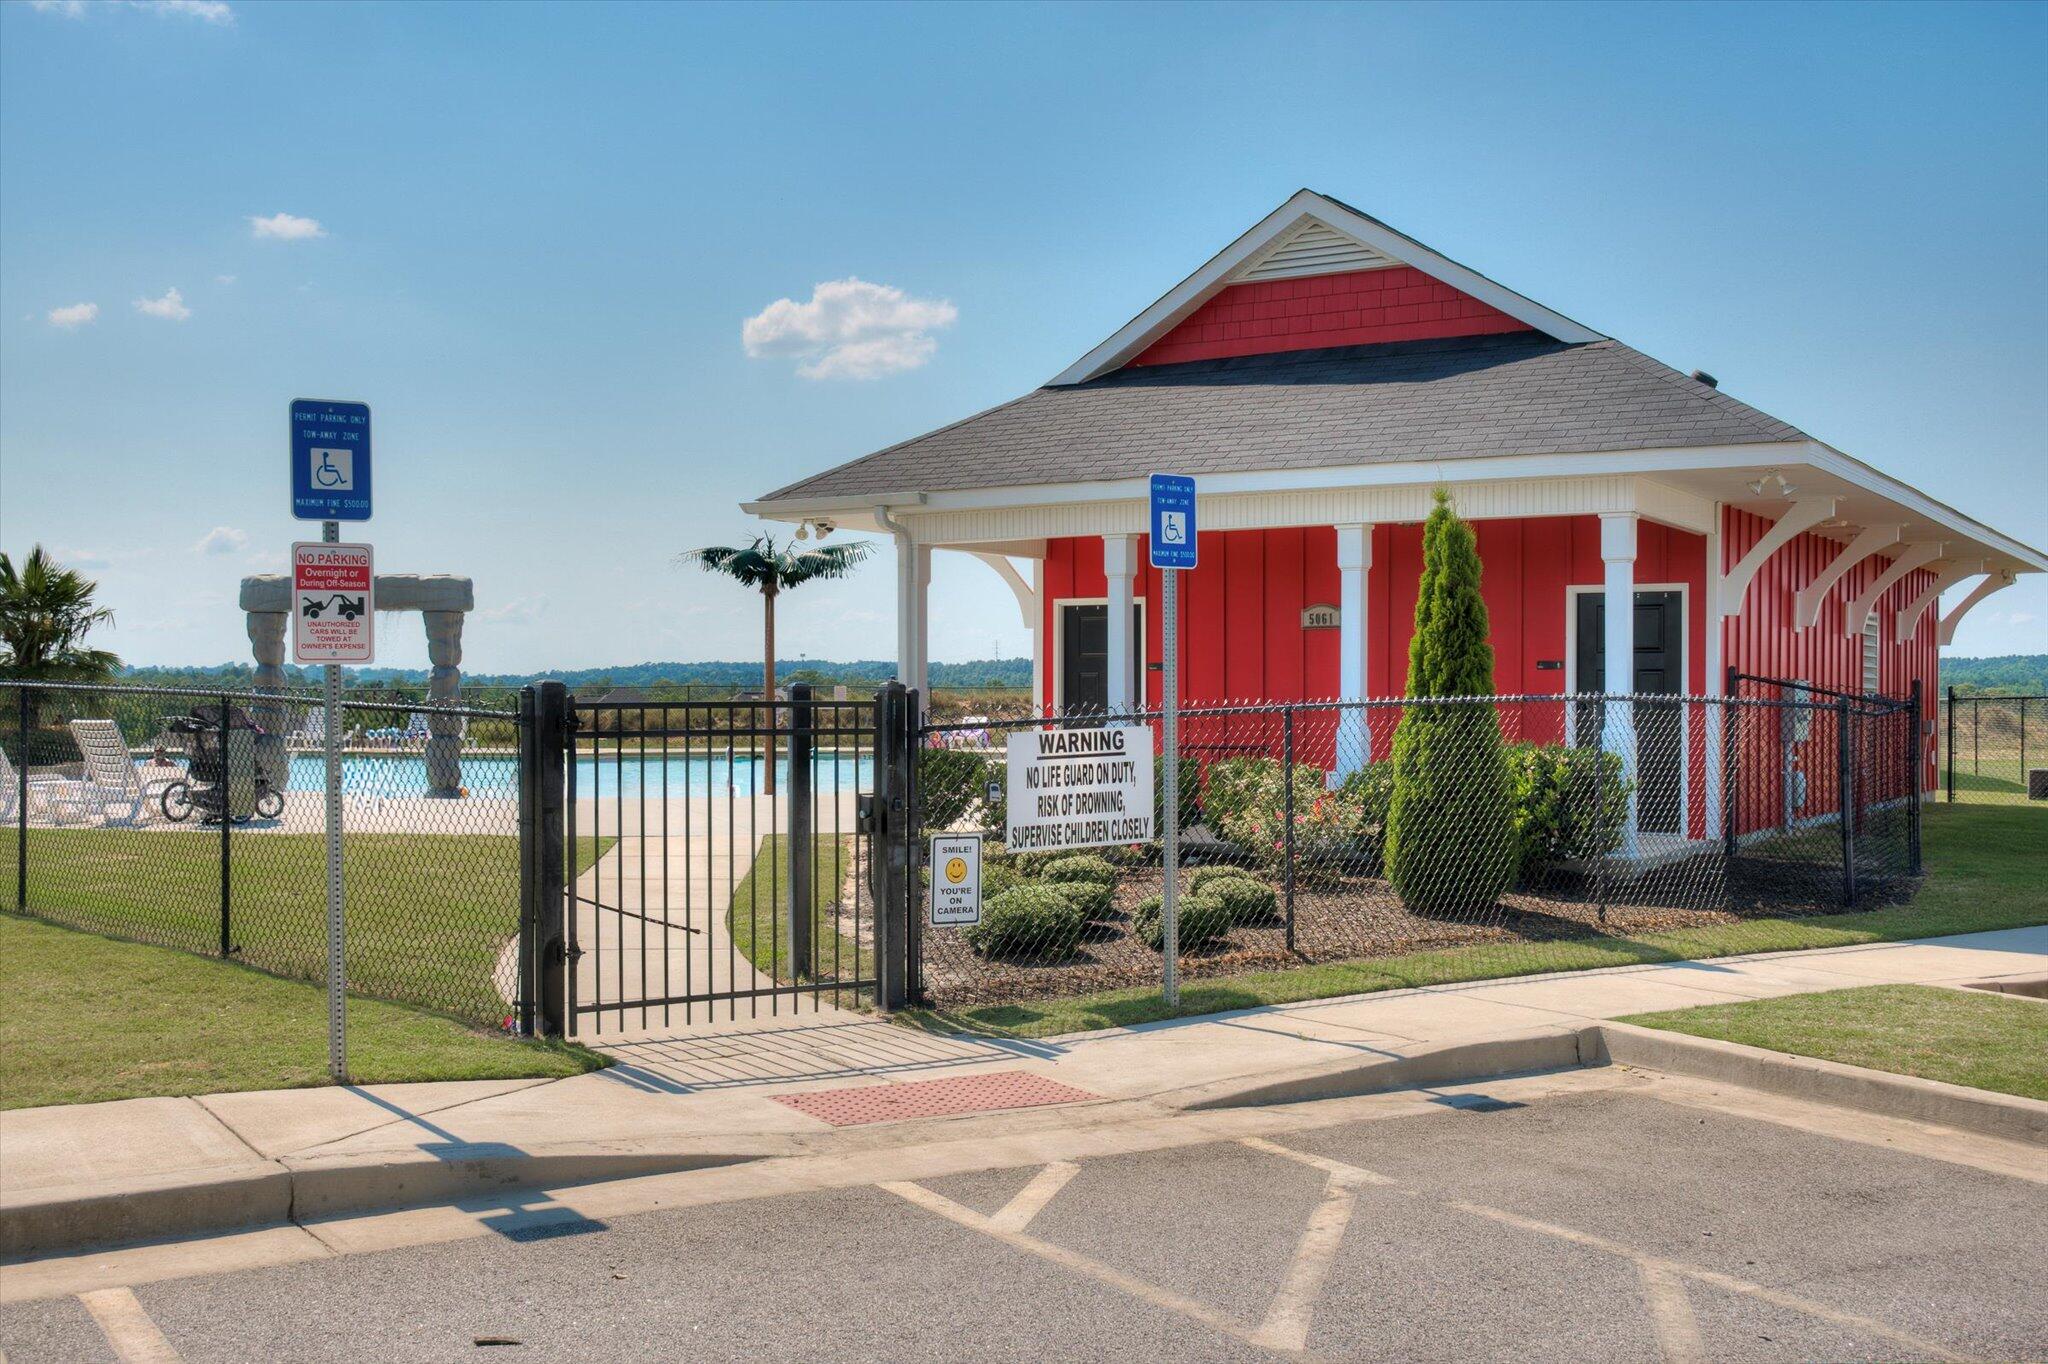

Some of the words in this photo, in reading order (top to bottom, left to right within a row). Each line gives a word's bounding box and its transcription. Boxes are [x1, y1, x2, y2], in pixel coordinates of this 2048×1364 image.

[295, 412, 316, 422] PERMIT
[320, 413, 347, 423] PARKING
[351, 415, 366, 424] ONLY
[303, 429, 337, 440] TOW-AWAY
[343, 432, 360, 441] ZONE
[295, 498, 324, 507] MAXIMUM
[327, 498, 341, 507] FINE
[298, 553, 315, 564] NO
[317, 554, 368, 565] PARKING
[305, 567, 348, 579] Overnight
[349, 570, 359, 578] or
[300, 579, 325, 589] During
[326, 579, 367, 588] Off-Season
[1309, 613, 1333, 625] 5061
[1038, 730, 1124, 754] WARNING
[1026, 767, 1040, 789] NO
[1042, 765, 1061, 788] LIFE
[1063, 763, 1094, 787] GUARD
[1096, 762, 1109, 784] ON
[1111, 761, 1136, 787] DUTY,
[1037, 795, 1060, 818] RISK
[1061, 794, 1073, 816] OF
[1075, 790, 1126, 817] DROWNING,
[1012, 823, 1063, 849] SUPERVISE
[1064, 820, 1109, 845] CHILDREN
[1111, 817, 1150, 841] CLOSELY
[942, 846, 972, 854] SMILE!
[940, 887, 972, 895] YOU'RE
[937, 906, 974, 915] CAMERA
